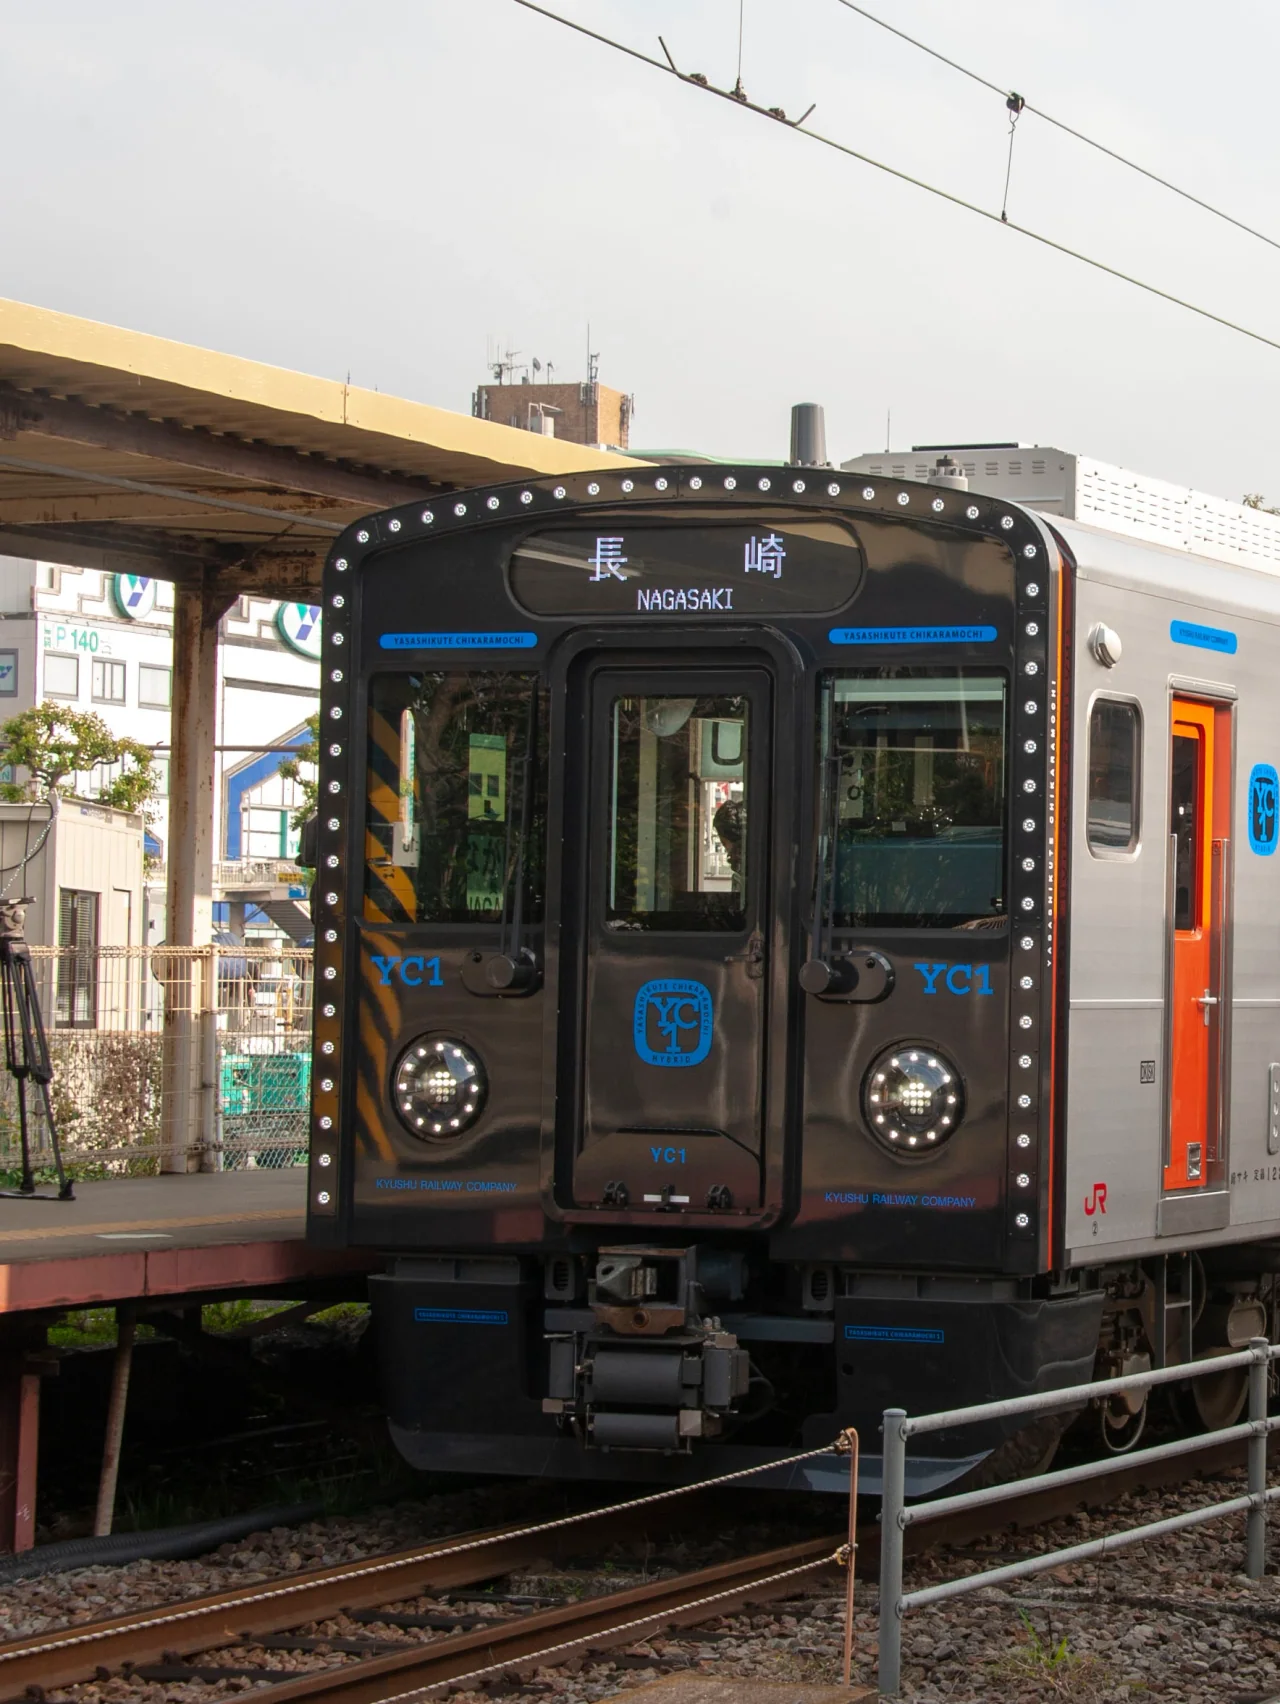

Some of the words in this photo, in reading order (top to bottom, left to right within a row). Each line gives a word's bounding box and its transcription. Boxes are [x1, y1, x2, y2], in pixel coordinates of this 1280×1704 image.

[637, 588, 733, 610] NAGASAKI
[71, 629, 99, 652] 140
[393, 635, 453, 646] YASASHIKUTE
[455, 635, 525, 645] CHIKARAMOCHI
[843, 631, 907, 641] YASASHIKUTE
[909, 629, 984, 640] CHIKARAMOCHI
[1048, 680, 1057, 825] CHIKARAMOCHI
[1046, 837, 1055, 967] YASASHIKUTE
[370, 956, 444, 986] YC1
[913, 963, 994, 995] YC1
[652, 1055, 691, 1064] HYBRID
[651, 1148, 687, 1163] YC1
[376, 1178, 418, 1189] KYUSHU
[420, 1179, 463, 1191] RAILWAY
[466, 1181, 517, 1192] COMPANY
[824, 1192, 869, 1204] KYUSHU
[872, 1193, 918, 1205] RAILWAY
[921, 1195, 976, 1207] COMPANY
[1084, 1183, 1107, 1216] JR
